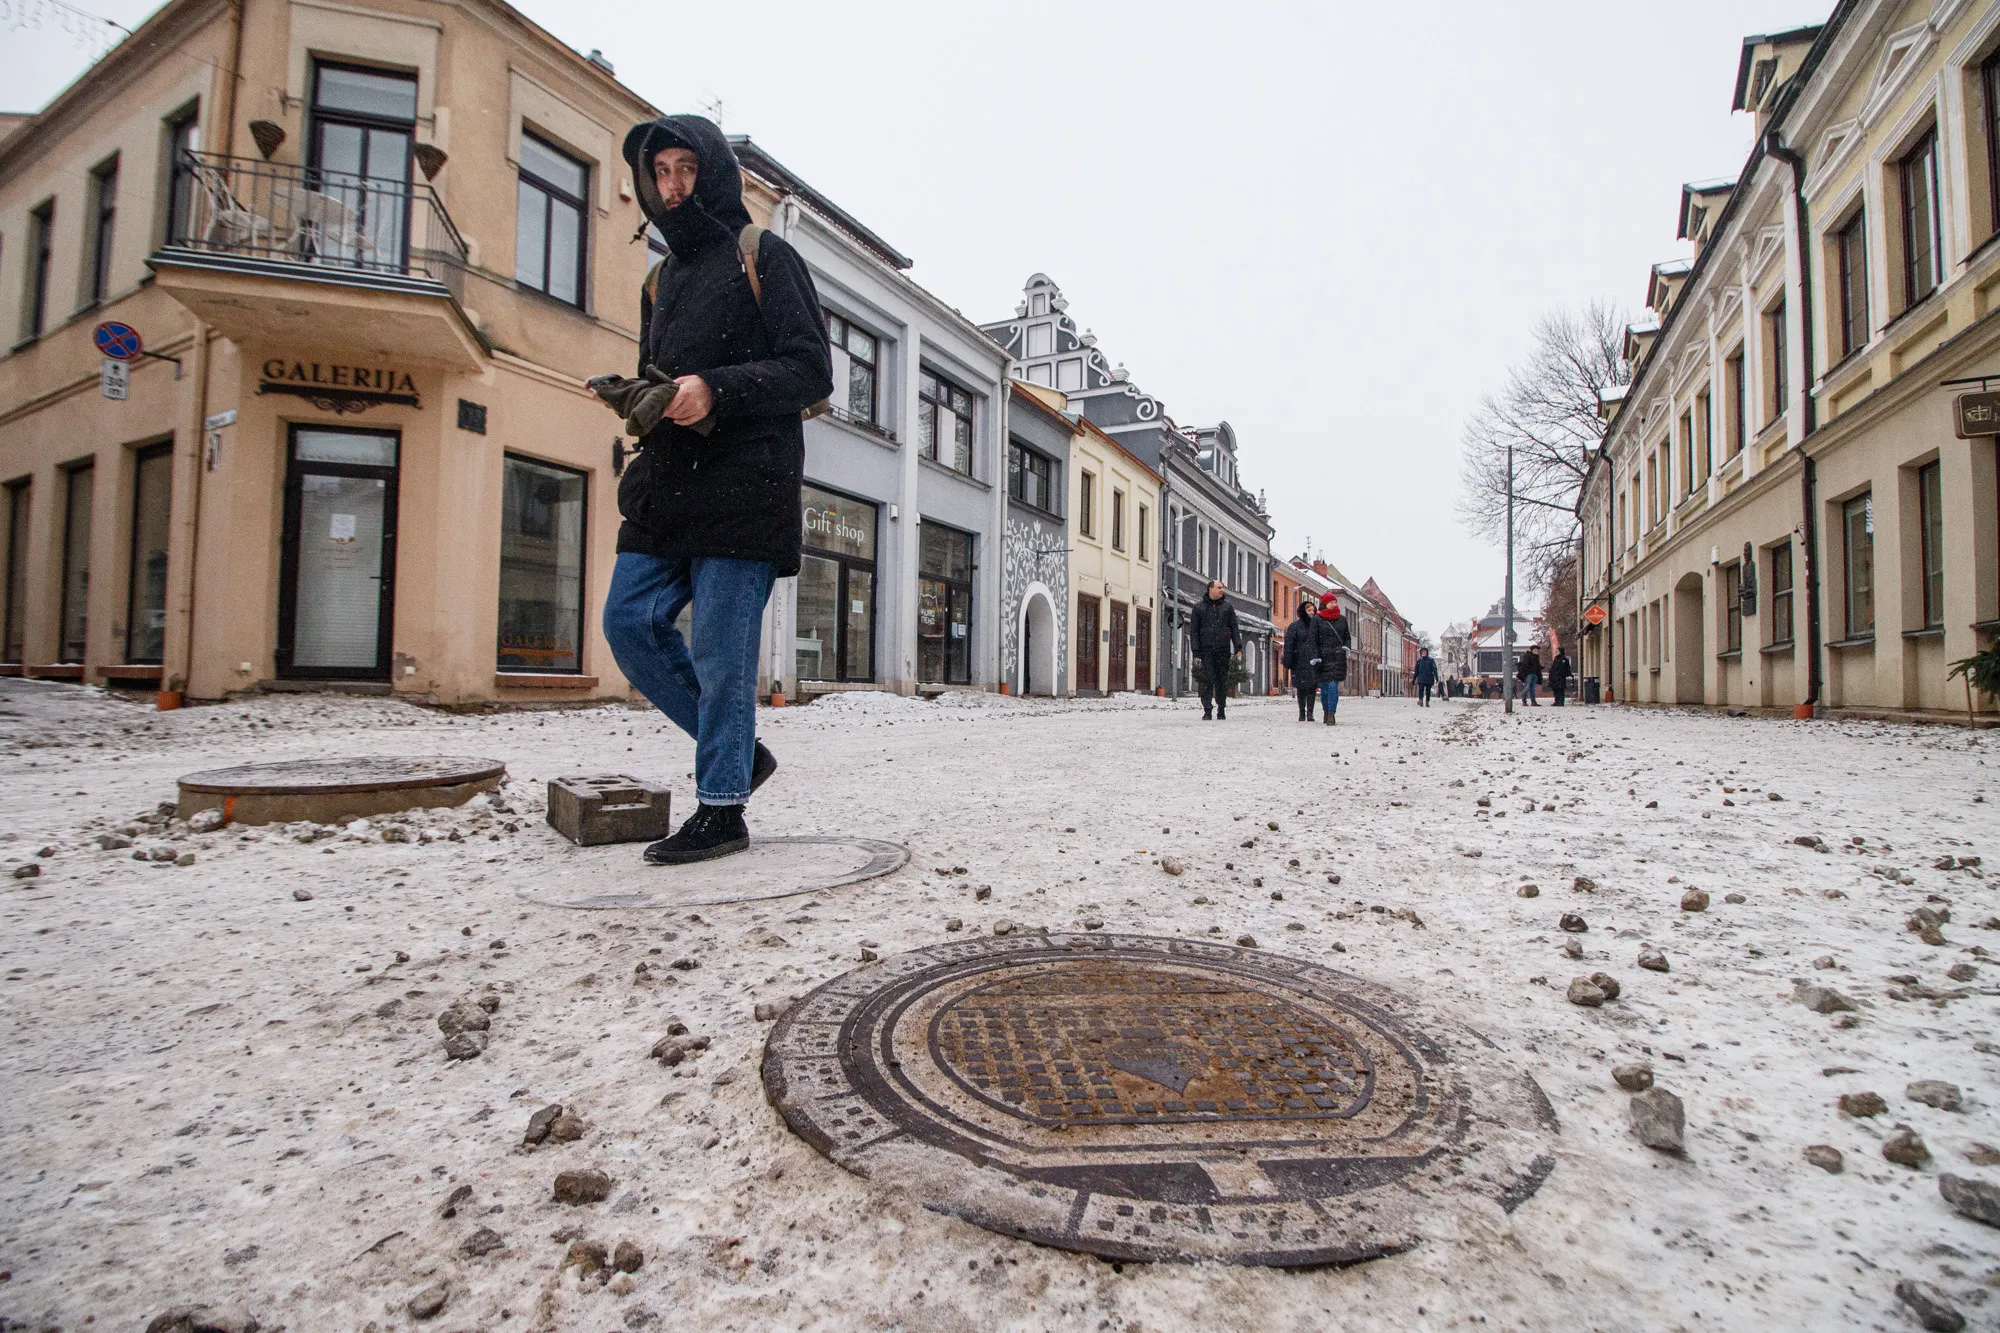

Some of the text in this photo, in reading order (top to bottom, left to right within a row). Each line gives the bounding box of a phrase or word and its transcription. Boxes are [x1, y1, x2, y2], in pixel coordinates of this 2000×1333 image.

[262, 358, 417, 394] GALERIJA
[803, 507, 865, 547] Gift shop
